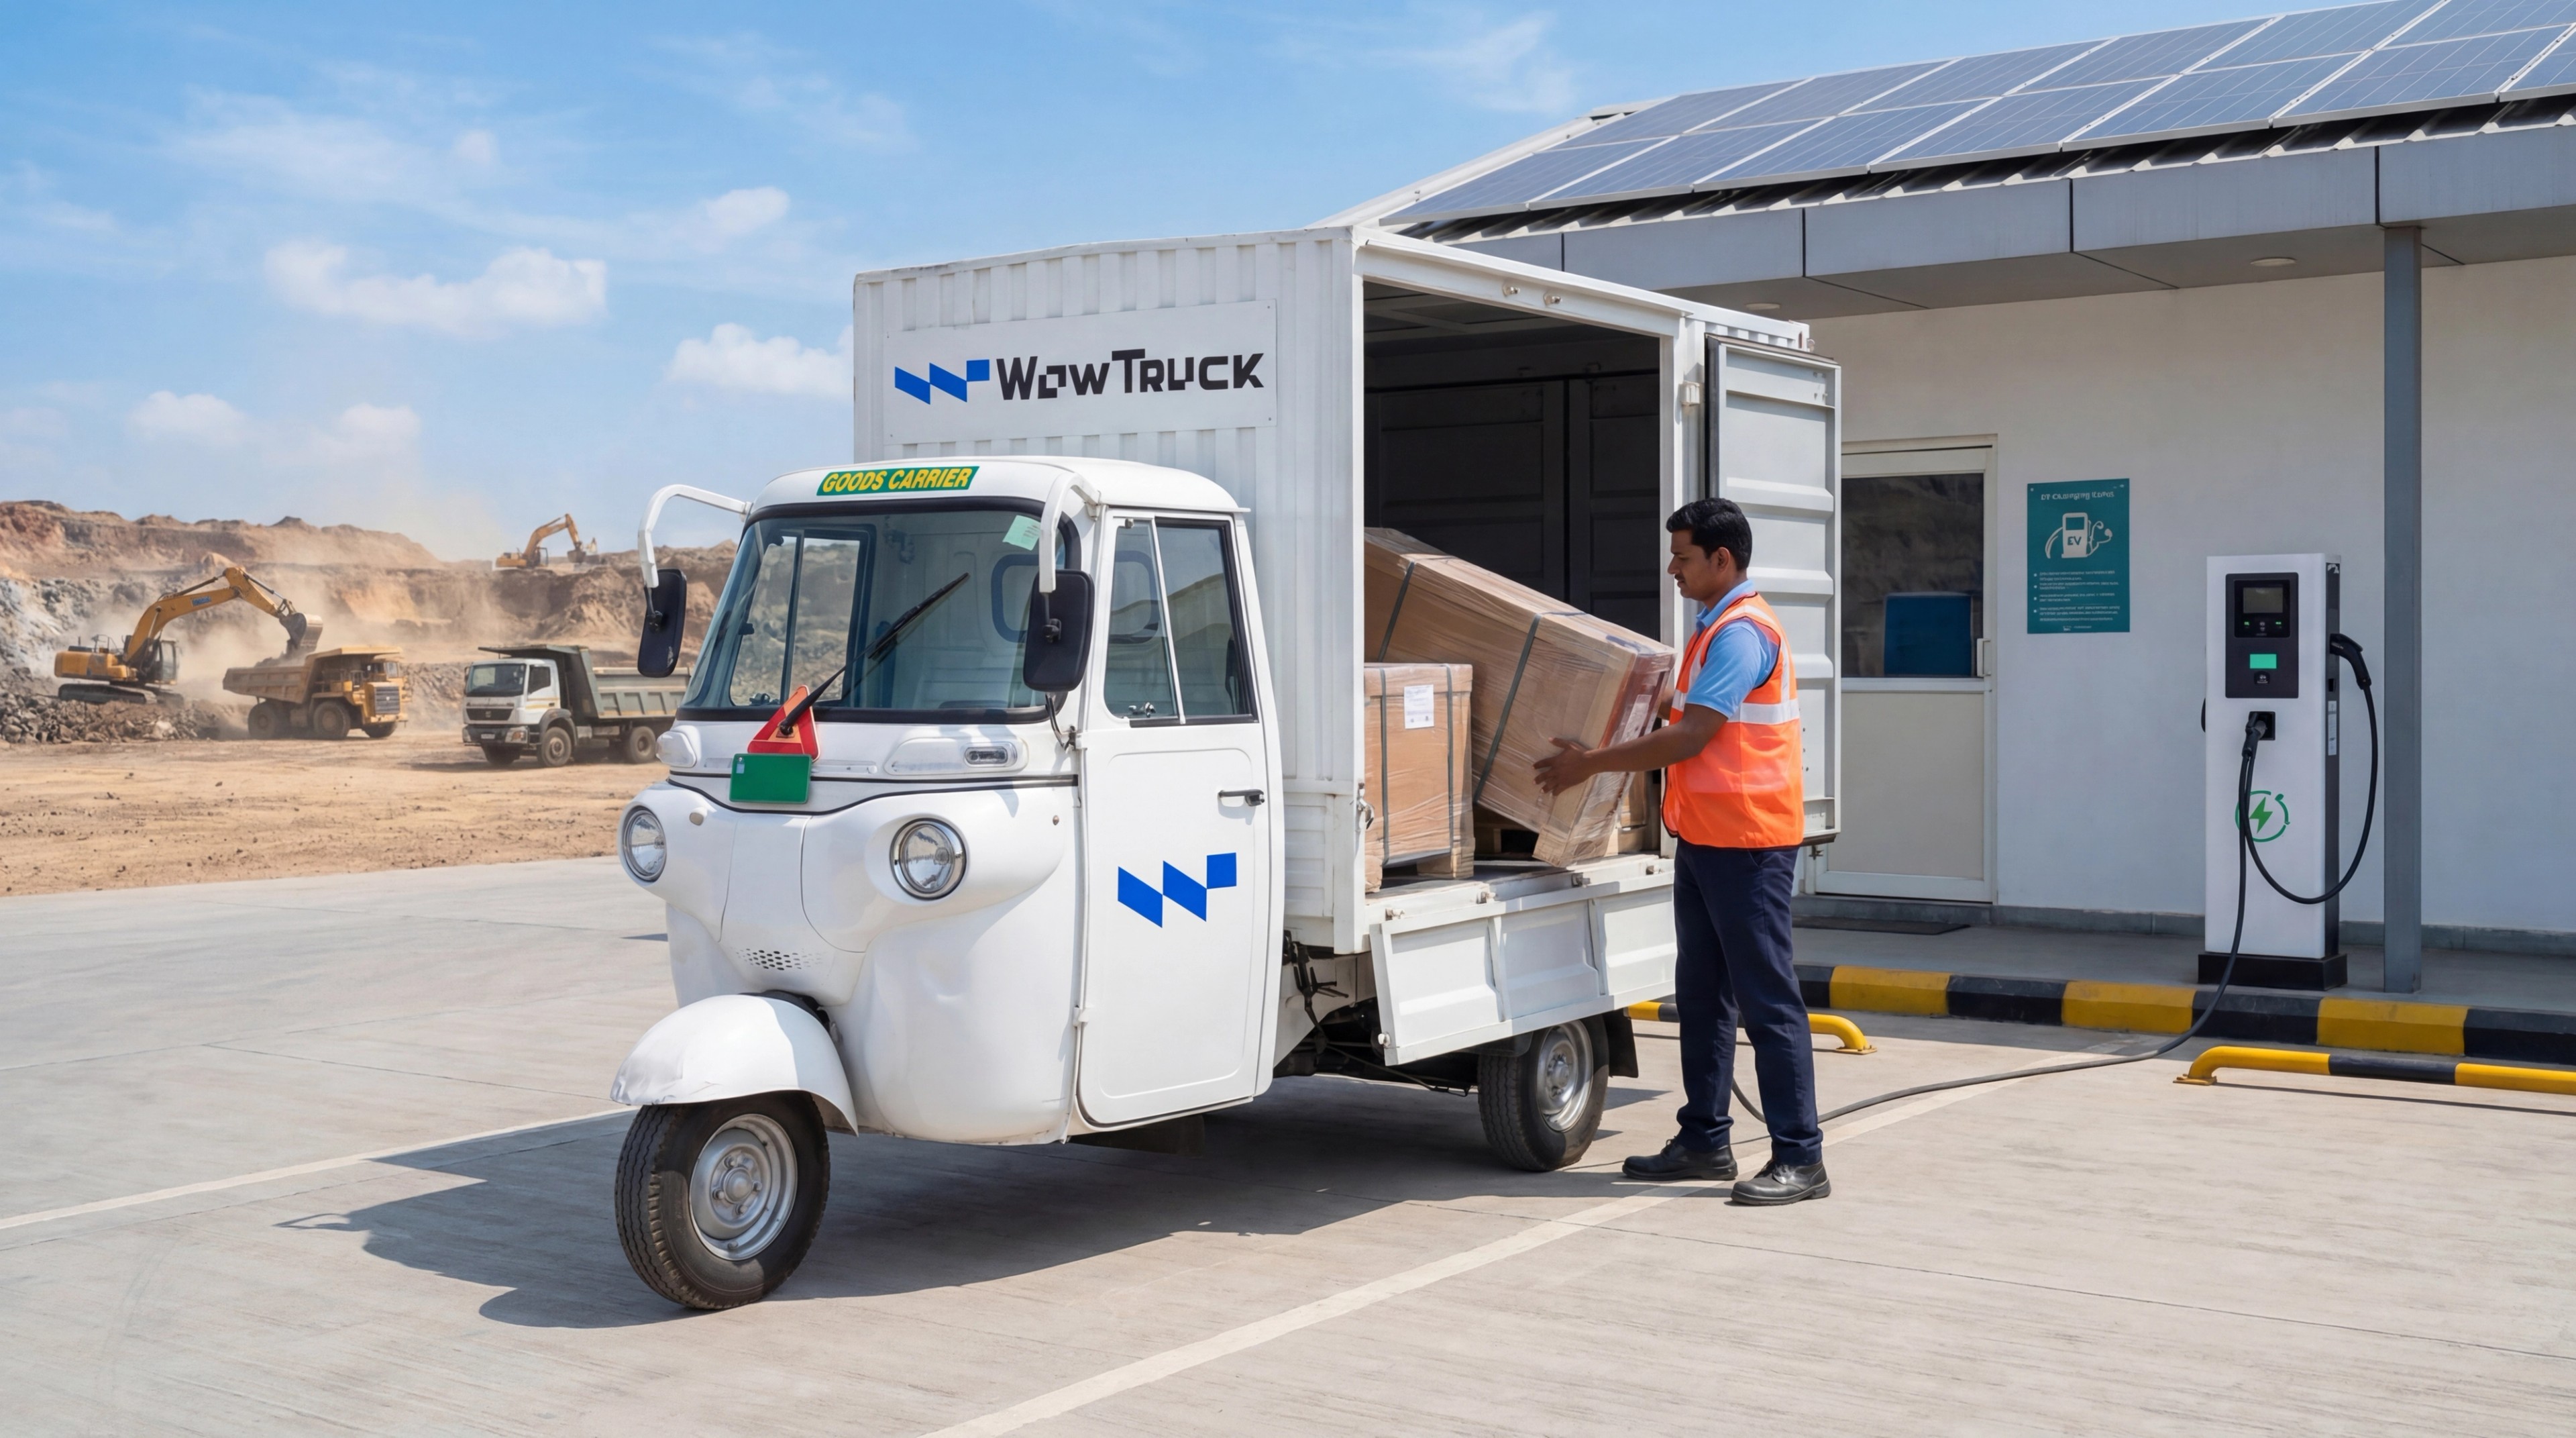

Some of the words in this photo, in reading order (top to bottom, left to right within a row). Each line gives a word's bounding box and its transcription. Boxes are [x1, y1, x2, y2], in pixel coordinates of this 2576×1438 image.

[822, 470, 888, 493] GOODS
[888, 468, 973, 490] CARRIER
[2067, 536, 2082, 546] EV
